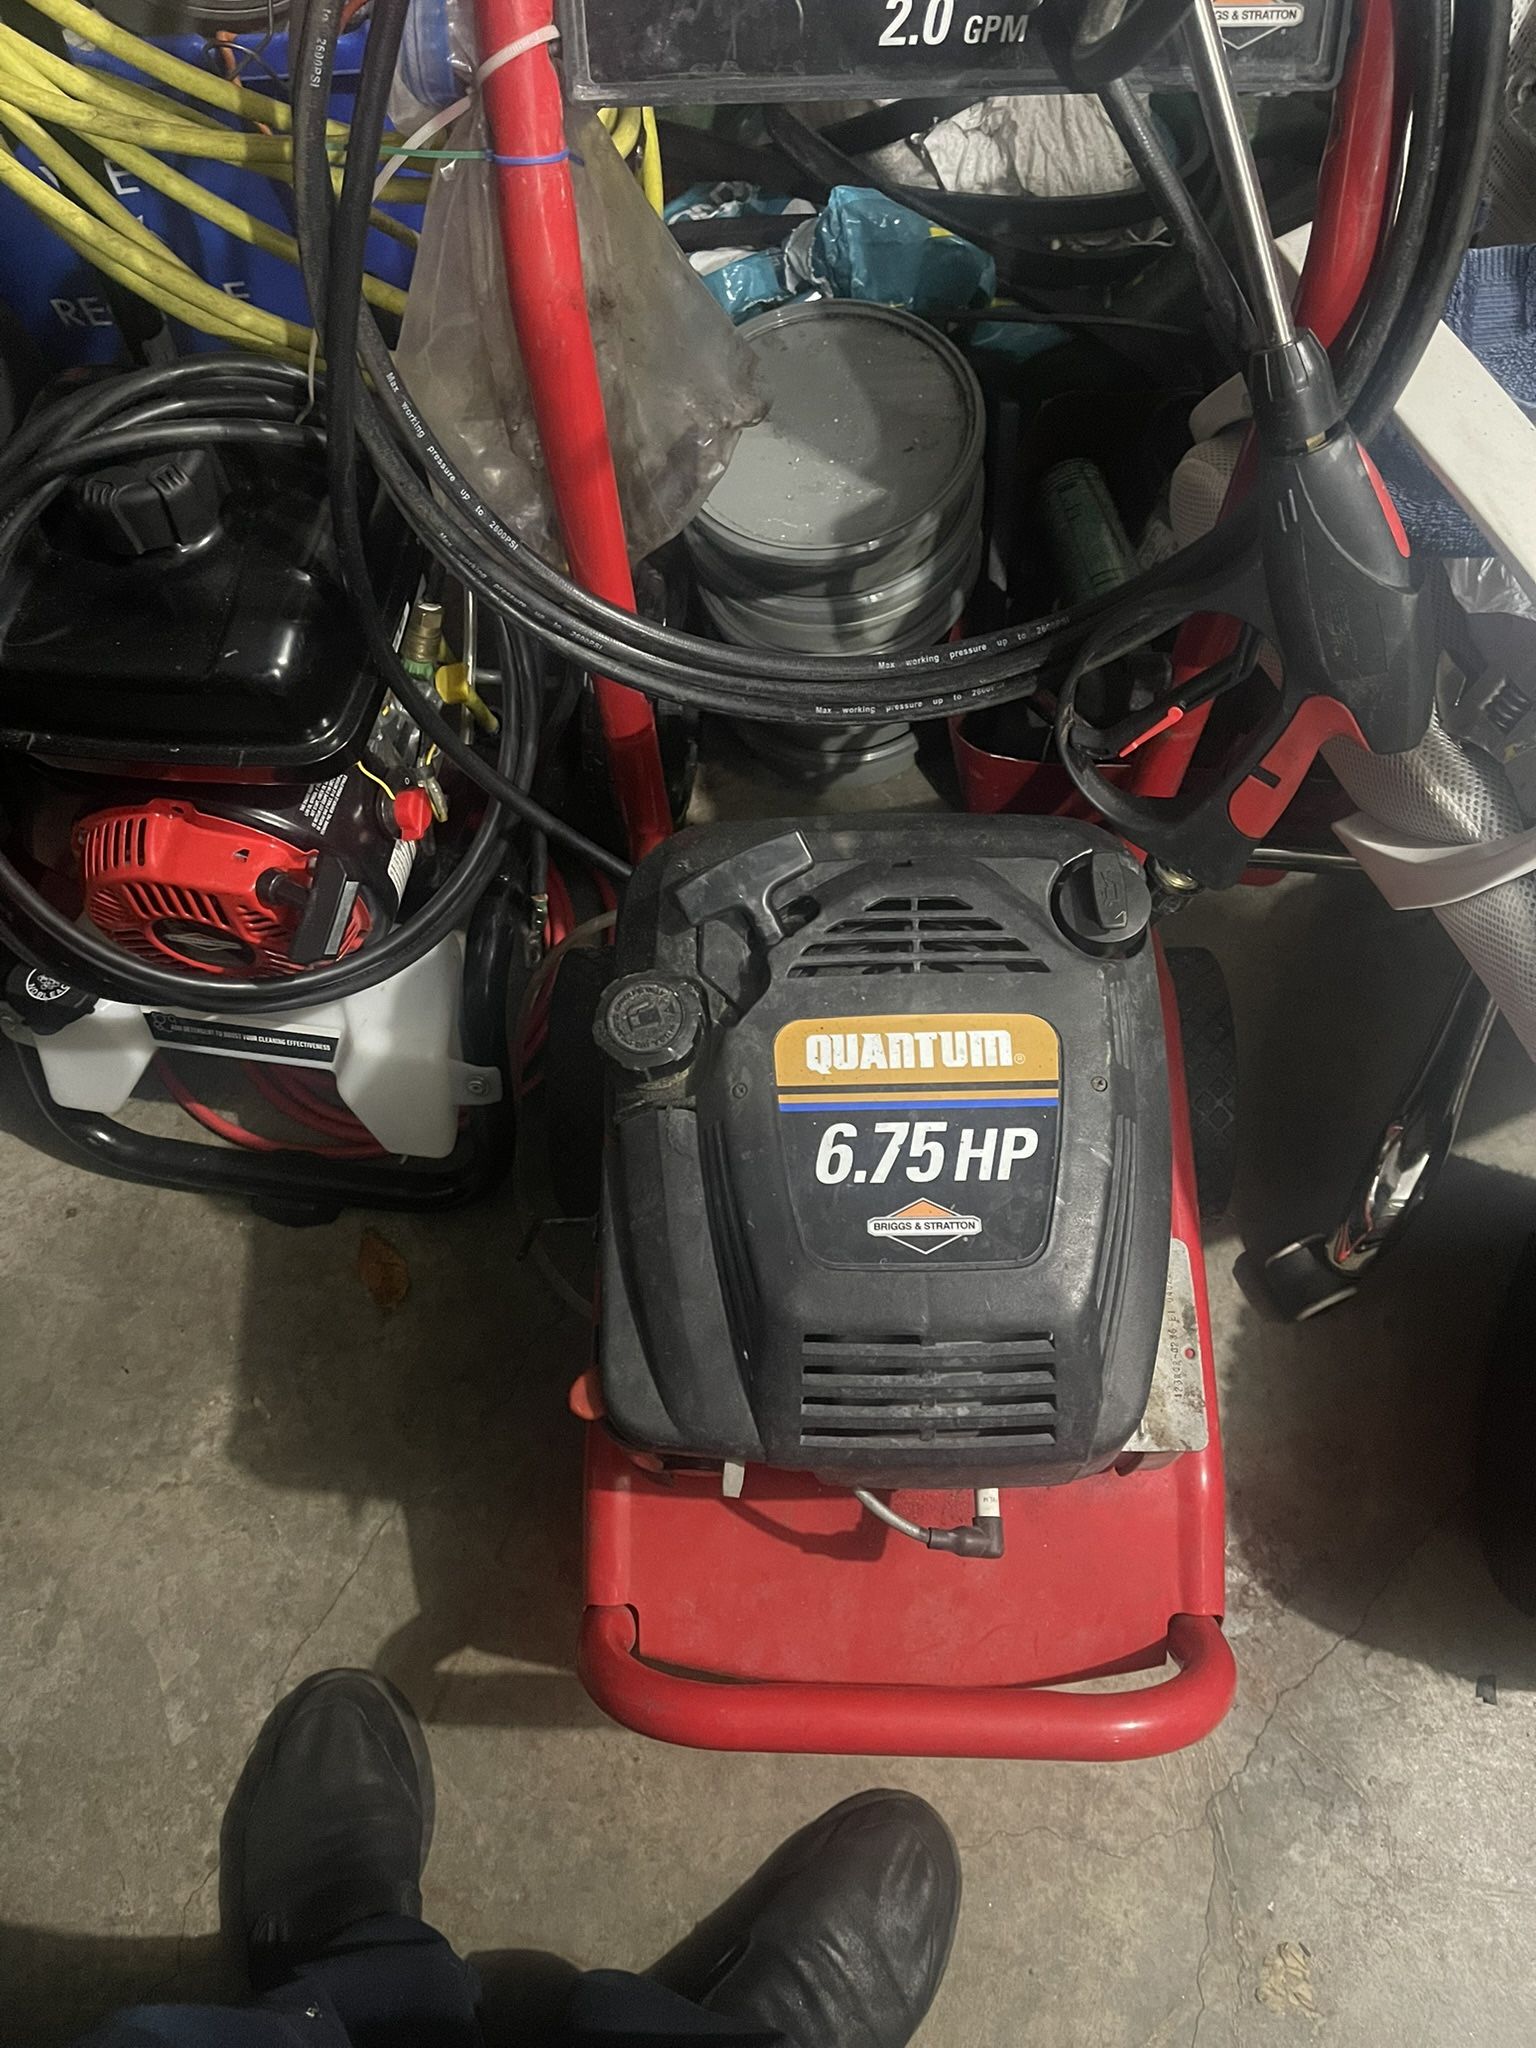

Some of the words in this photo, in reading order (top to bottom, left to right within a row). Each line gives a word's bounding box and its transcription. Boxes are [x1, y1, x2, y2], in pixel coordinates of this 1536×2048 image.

[878, 0, 955, 46] 2.0
[963, 14, 1030, 44] GPM
[1241, 9, 1298, 20] STRATTON
[385, 371, 400, 393] Max
[400, 401, 425, 439] working
[426, 445, 456, 482] pressure
[459, 488, 471, 502] up
[474, 505, 485, 517] to
[488, 520, 520, 551] 2600PSI
[878, 660, 896, 670] Max
[905, 654, 940, 667] working
[948, 642, 988, 660] pressure
[996, 637, 1008, 648] up
[1016, 631, 1027, 641] to
[815, 706, 832, 715] Max
[842, 705, 877, 715] working
[885, 700, 923, 713] pressure
[932, 697, 944, 706] up
[953, 693, 963, 701] to
[805, 1029, 1014, 1075] QUANTUM
[815, 1121, 948, 1185] 6.75
[954, 1127, 1039, 1182] HP
[873, 1221, 913, 1231] BRIGGS
[914, 1221, 922, 1231] &
[924, 1220, 976, 1231] STRATTON
